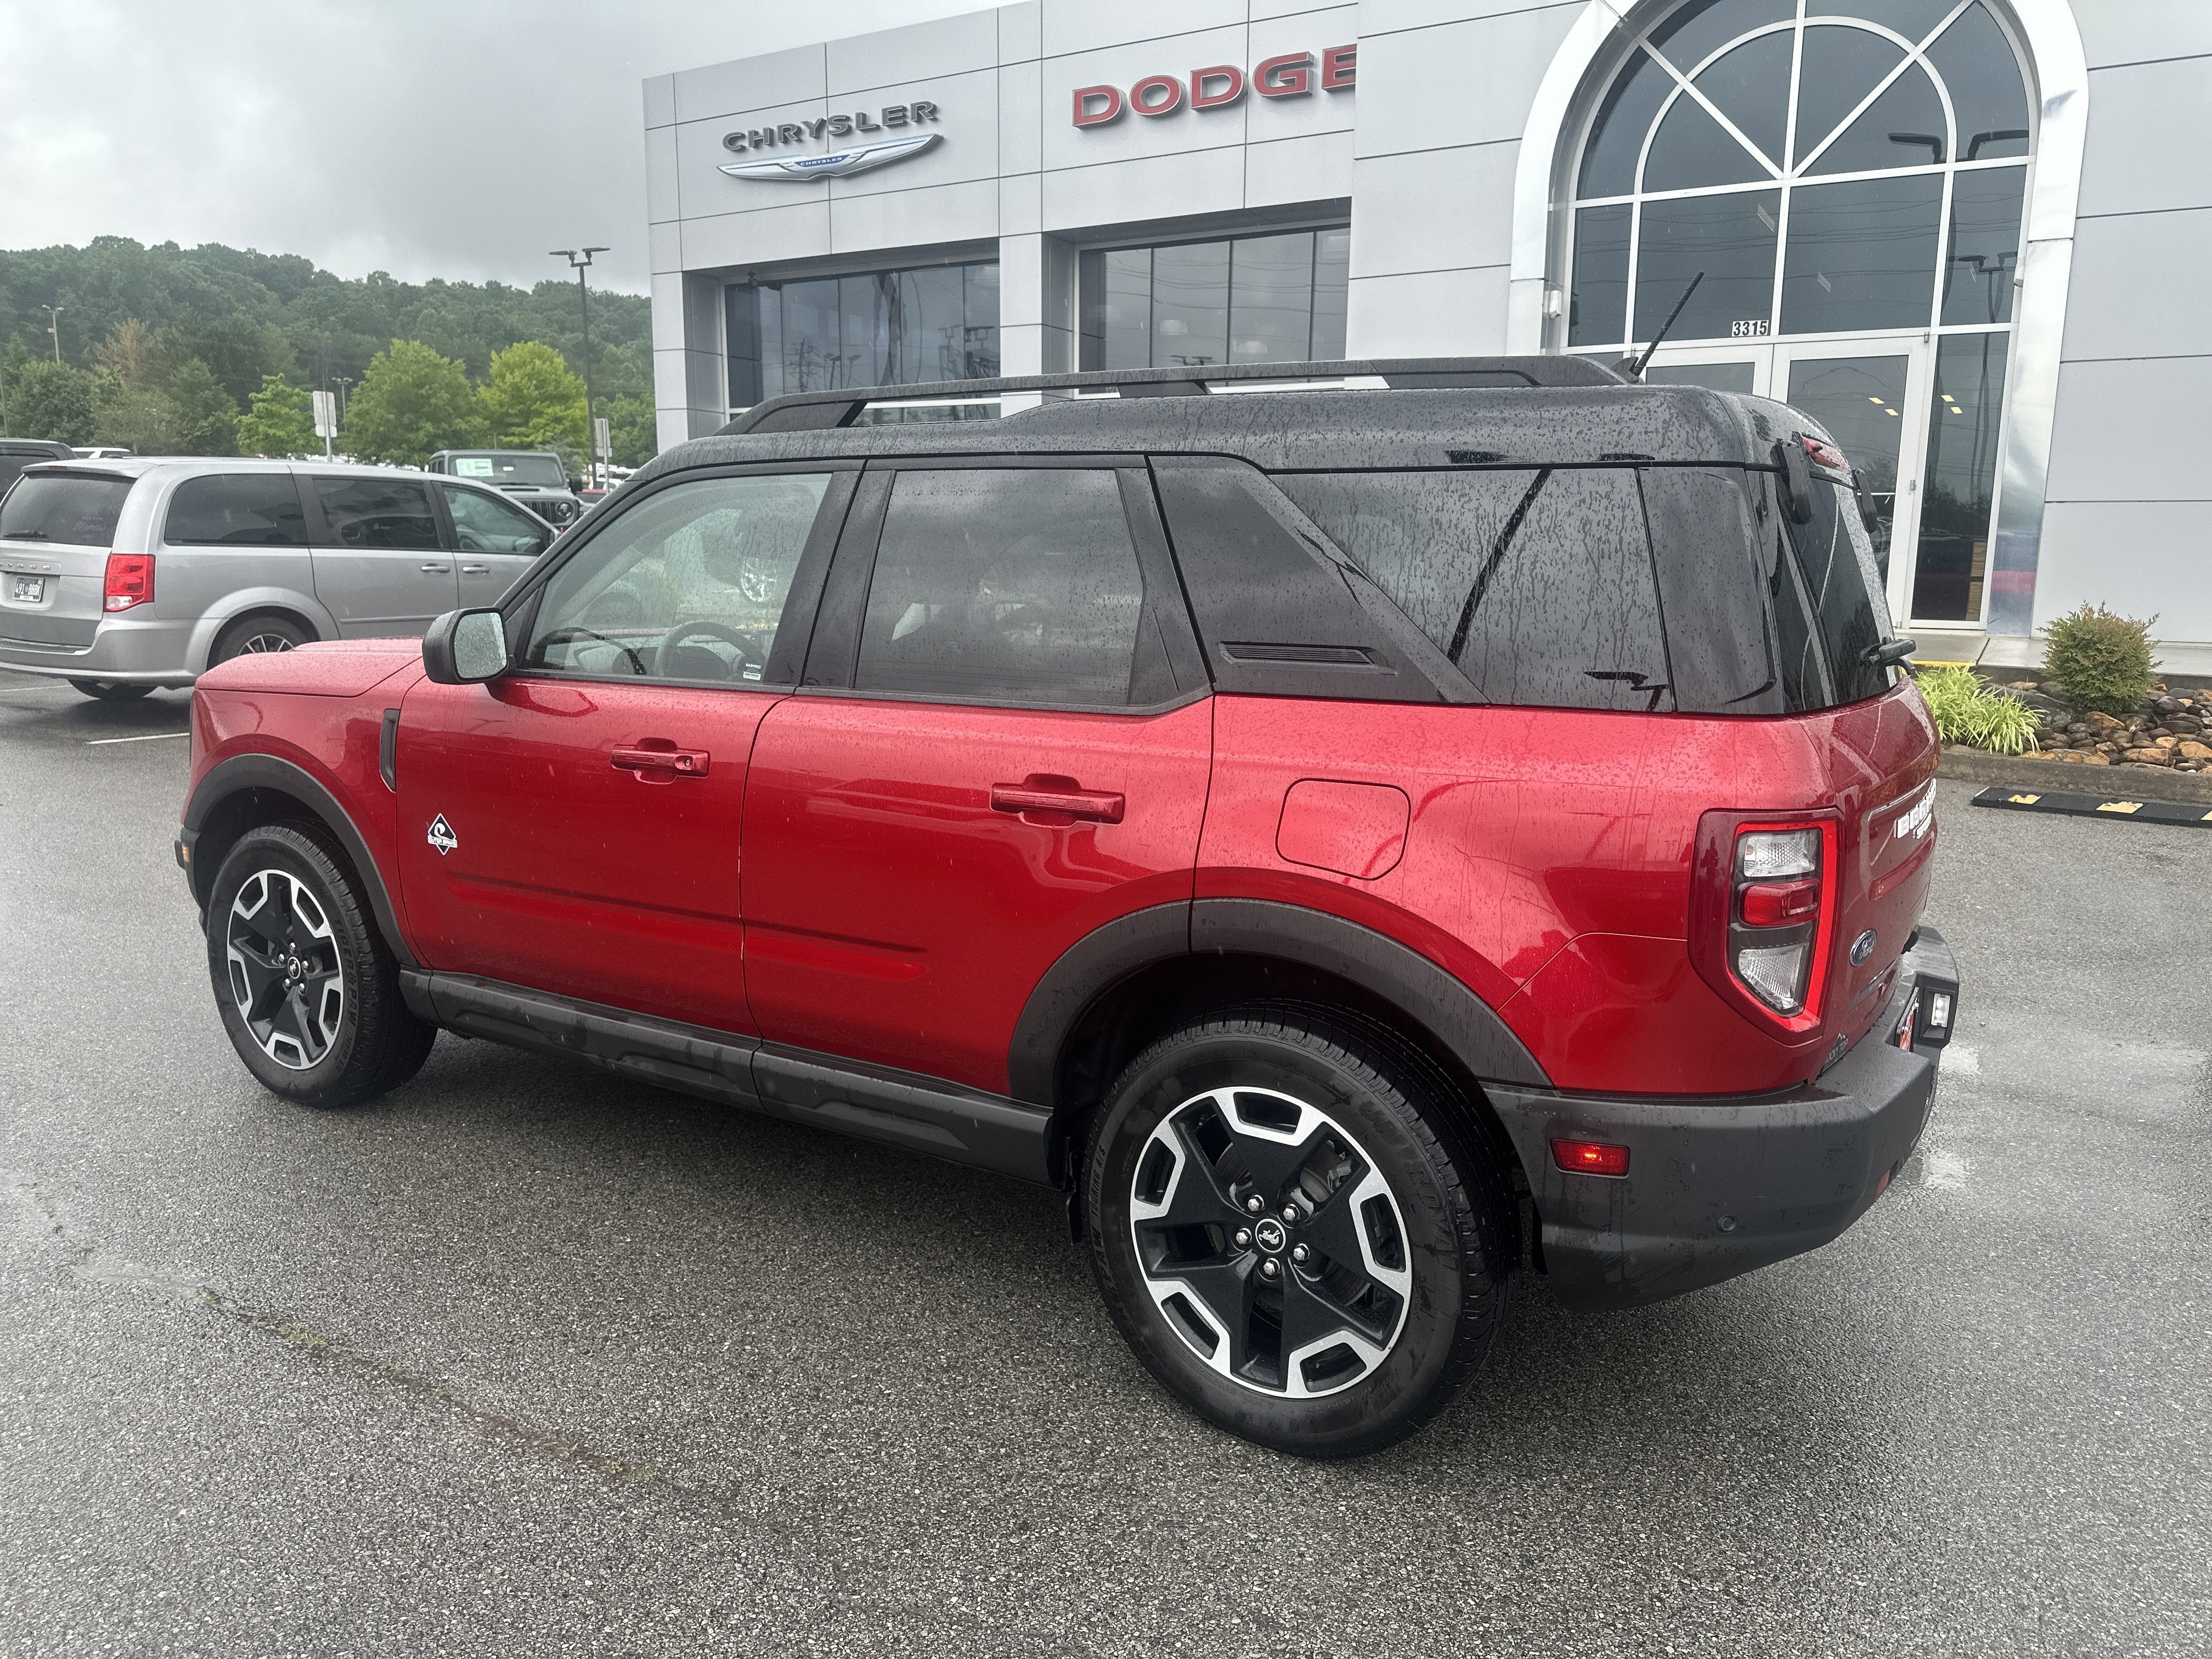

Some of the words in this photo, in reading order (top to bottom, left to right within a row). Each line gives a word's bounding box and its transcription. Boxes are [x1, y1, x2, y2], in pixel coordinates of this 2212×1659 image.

[1073, 43, 1357, 127] DODGE
[722, 100, 938, 151] CHRYSLER
[800, 156, 843, 166] CHRYSLER
[1733, 320, 1768, 336] 3315
[15, 582, 25, 595] 491
[347, 987, 358, 1027] PAW
[1091, 1169, 1101, 1217] TOURING
[1096, 1144, 1106, 1169] A/S
[1358, 1099, 1457, 1273] UNIROYAL
